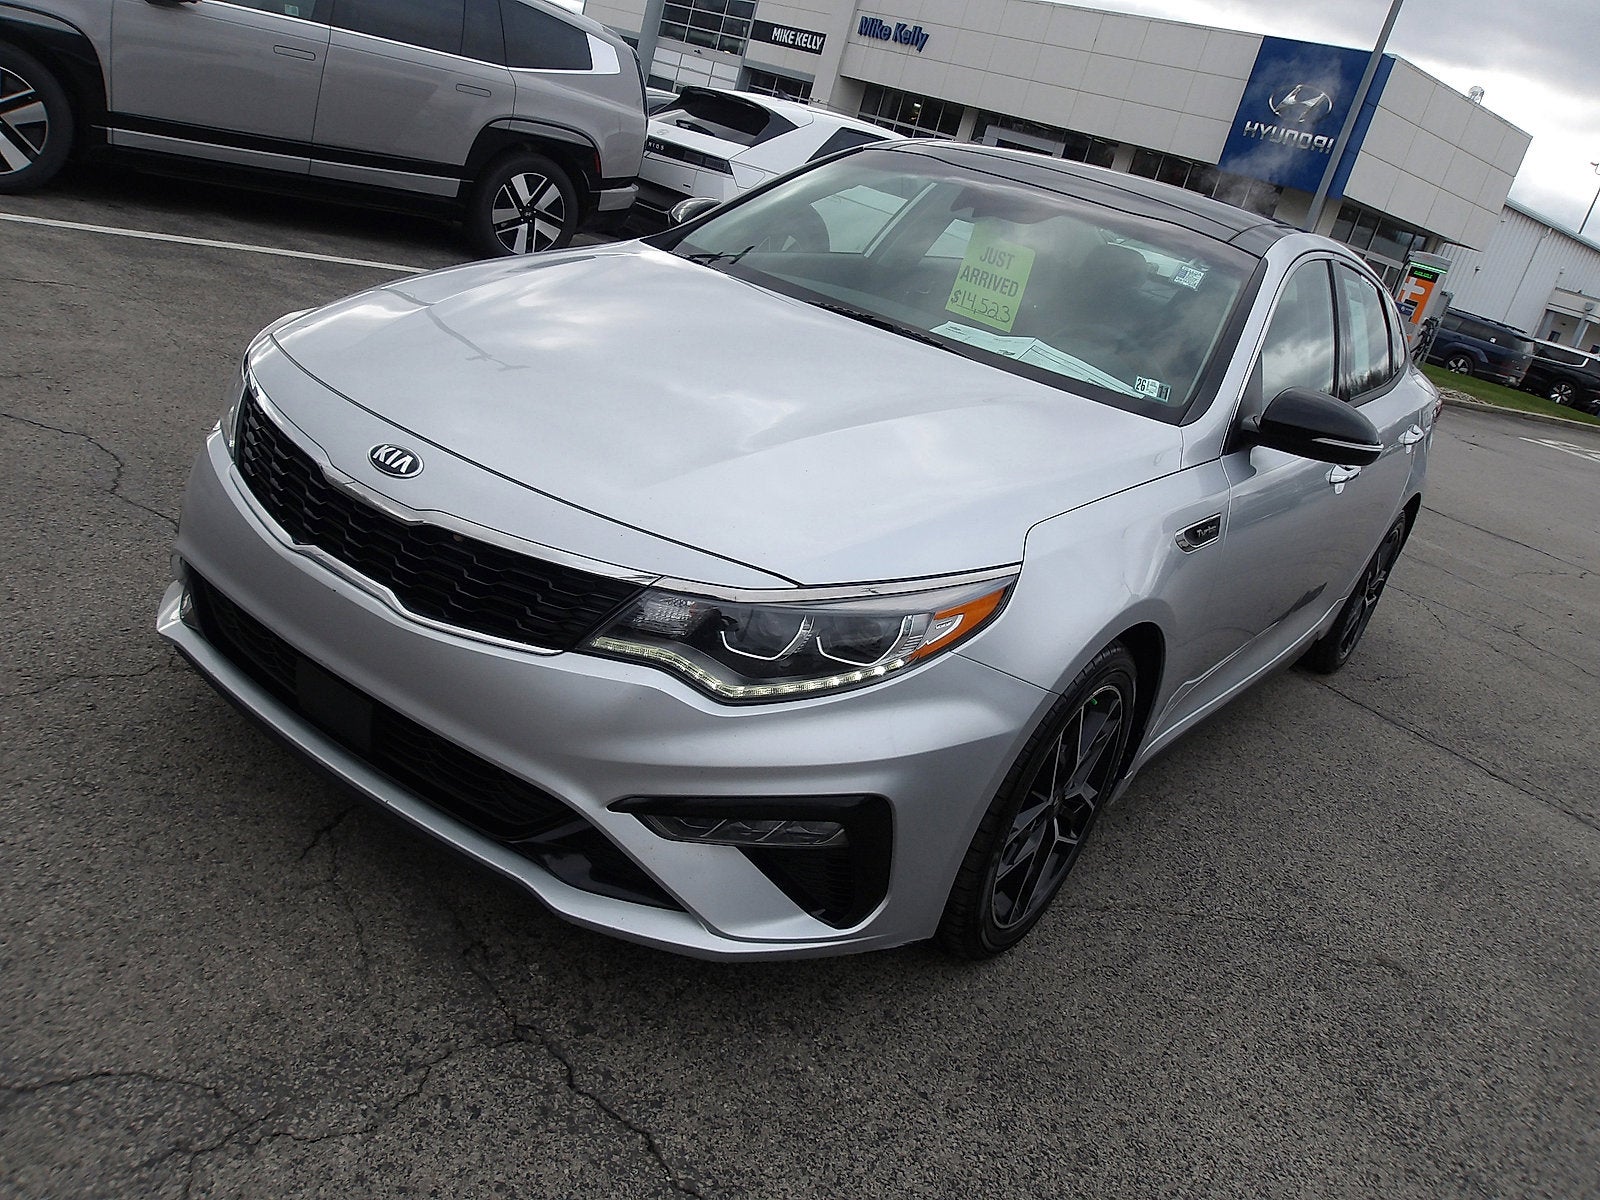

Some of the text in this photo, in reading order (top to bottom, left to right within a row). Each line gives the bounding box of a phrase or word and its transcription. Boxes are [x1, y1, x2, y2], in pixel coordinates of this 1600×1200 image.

[772, 26, 824, 50] MIKE KELLY
[858, 15, 930, 53] Mike Kelly
[1243, 120, 1335, 154] HYUNDAI
[980, 247, 1016, 270] JUST
[960, 265, 1019, 298] ARRIVED
[951, 289, 1011, 324] $14,523
[1136, 377, 1146, 392] 26
[372, 444, 414, 474] KIA
